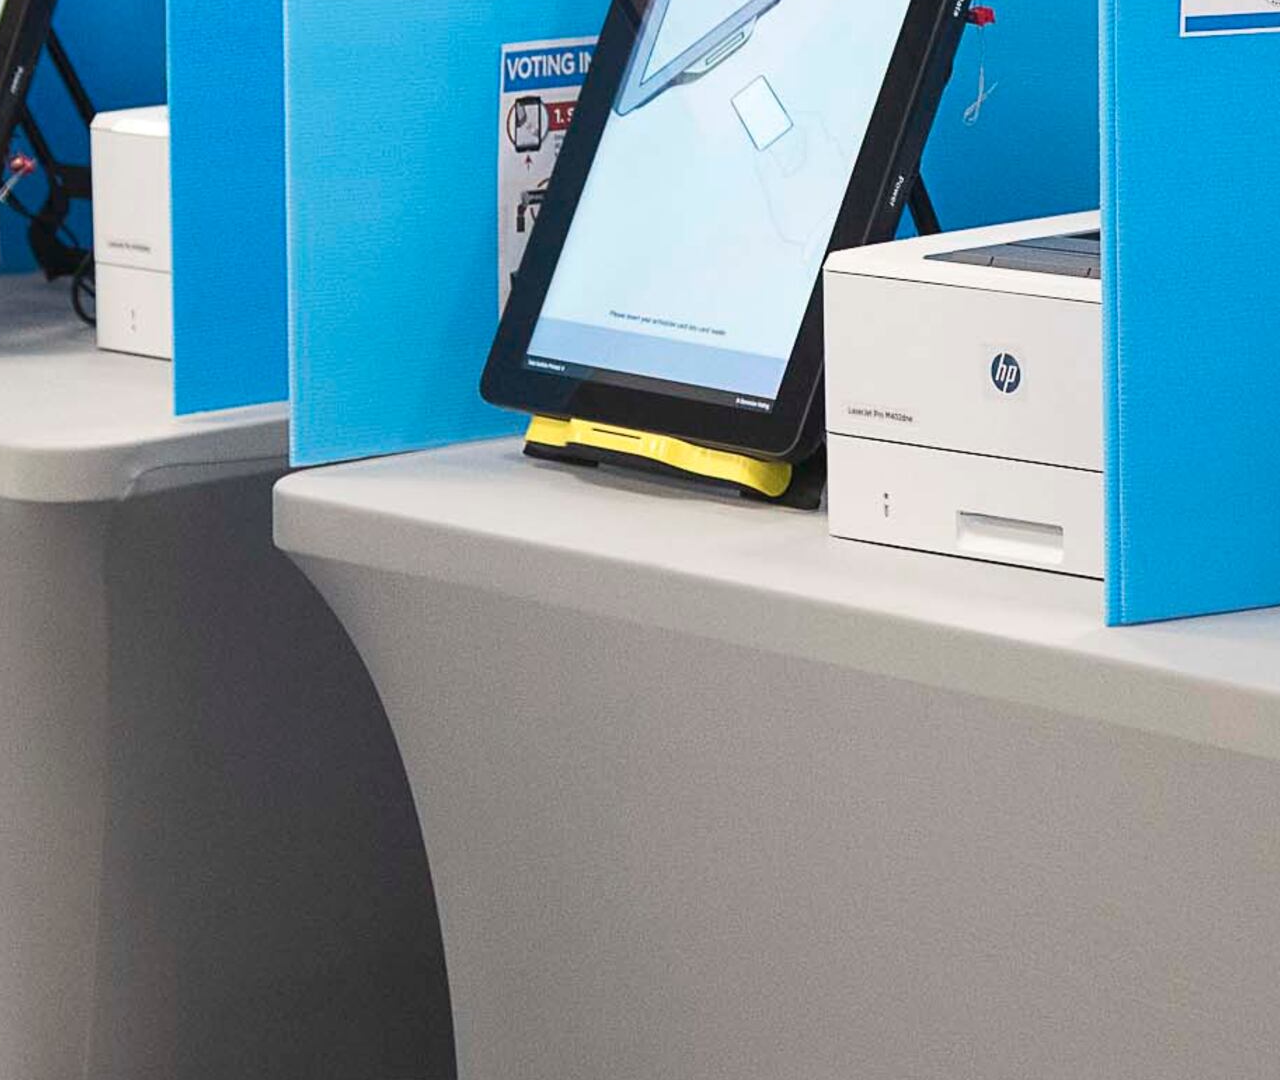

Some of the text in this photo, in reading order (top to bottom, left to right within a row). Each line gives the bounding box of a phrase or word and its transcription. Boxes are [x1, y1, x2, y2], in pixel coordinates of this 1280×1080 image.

[507, 52, 575, 80] VOTING
[554, 108, 564, 124] 1.
[993, 352, 1019, 393] hp
